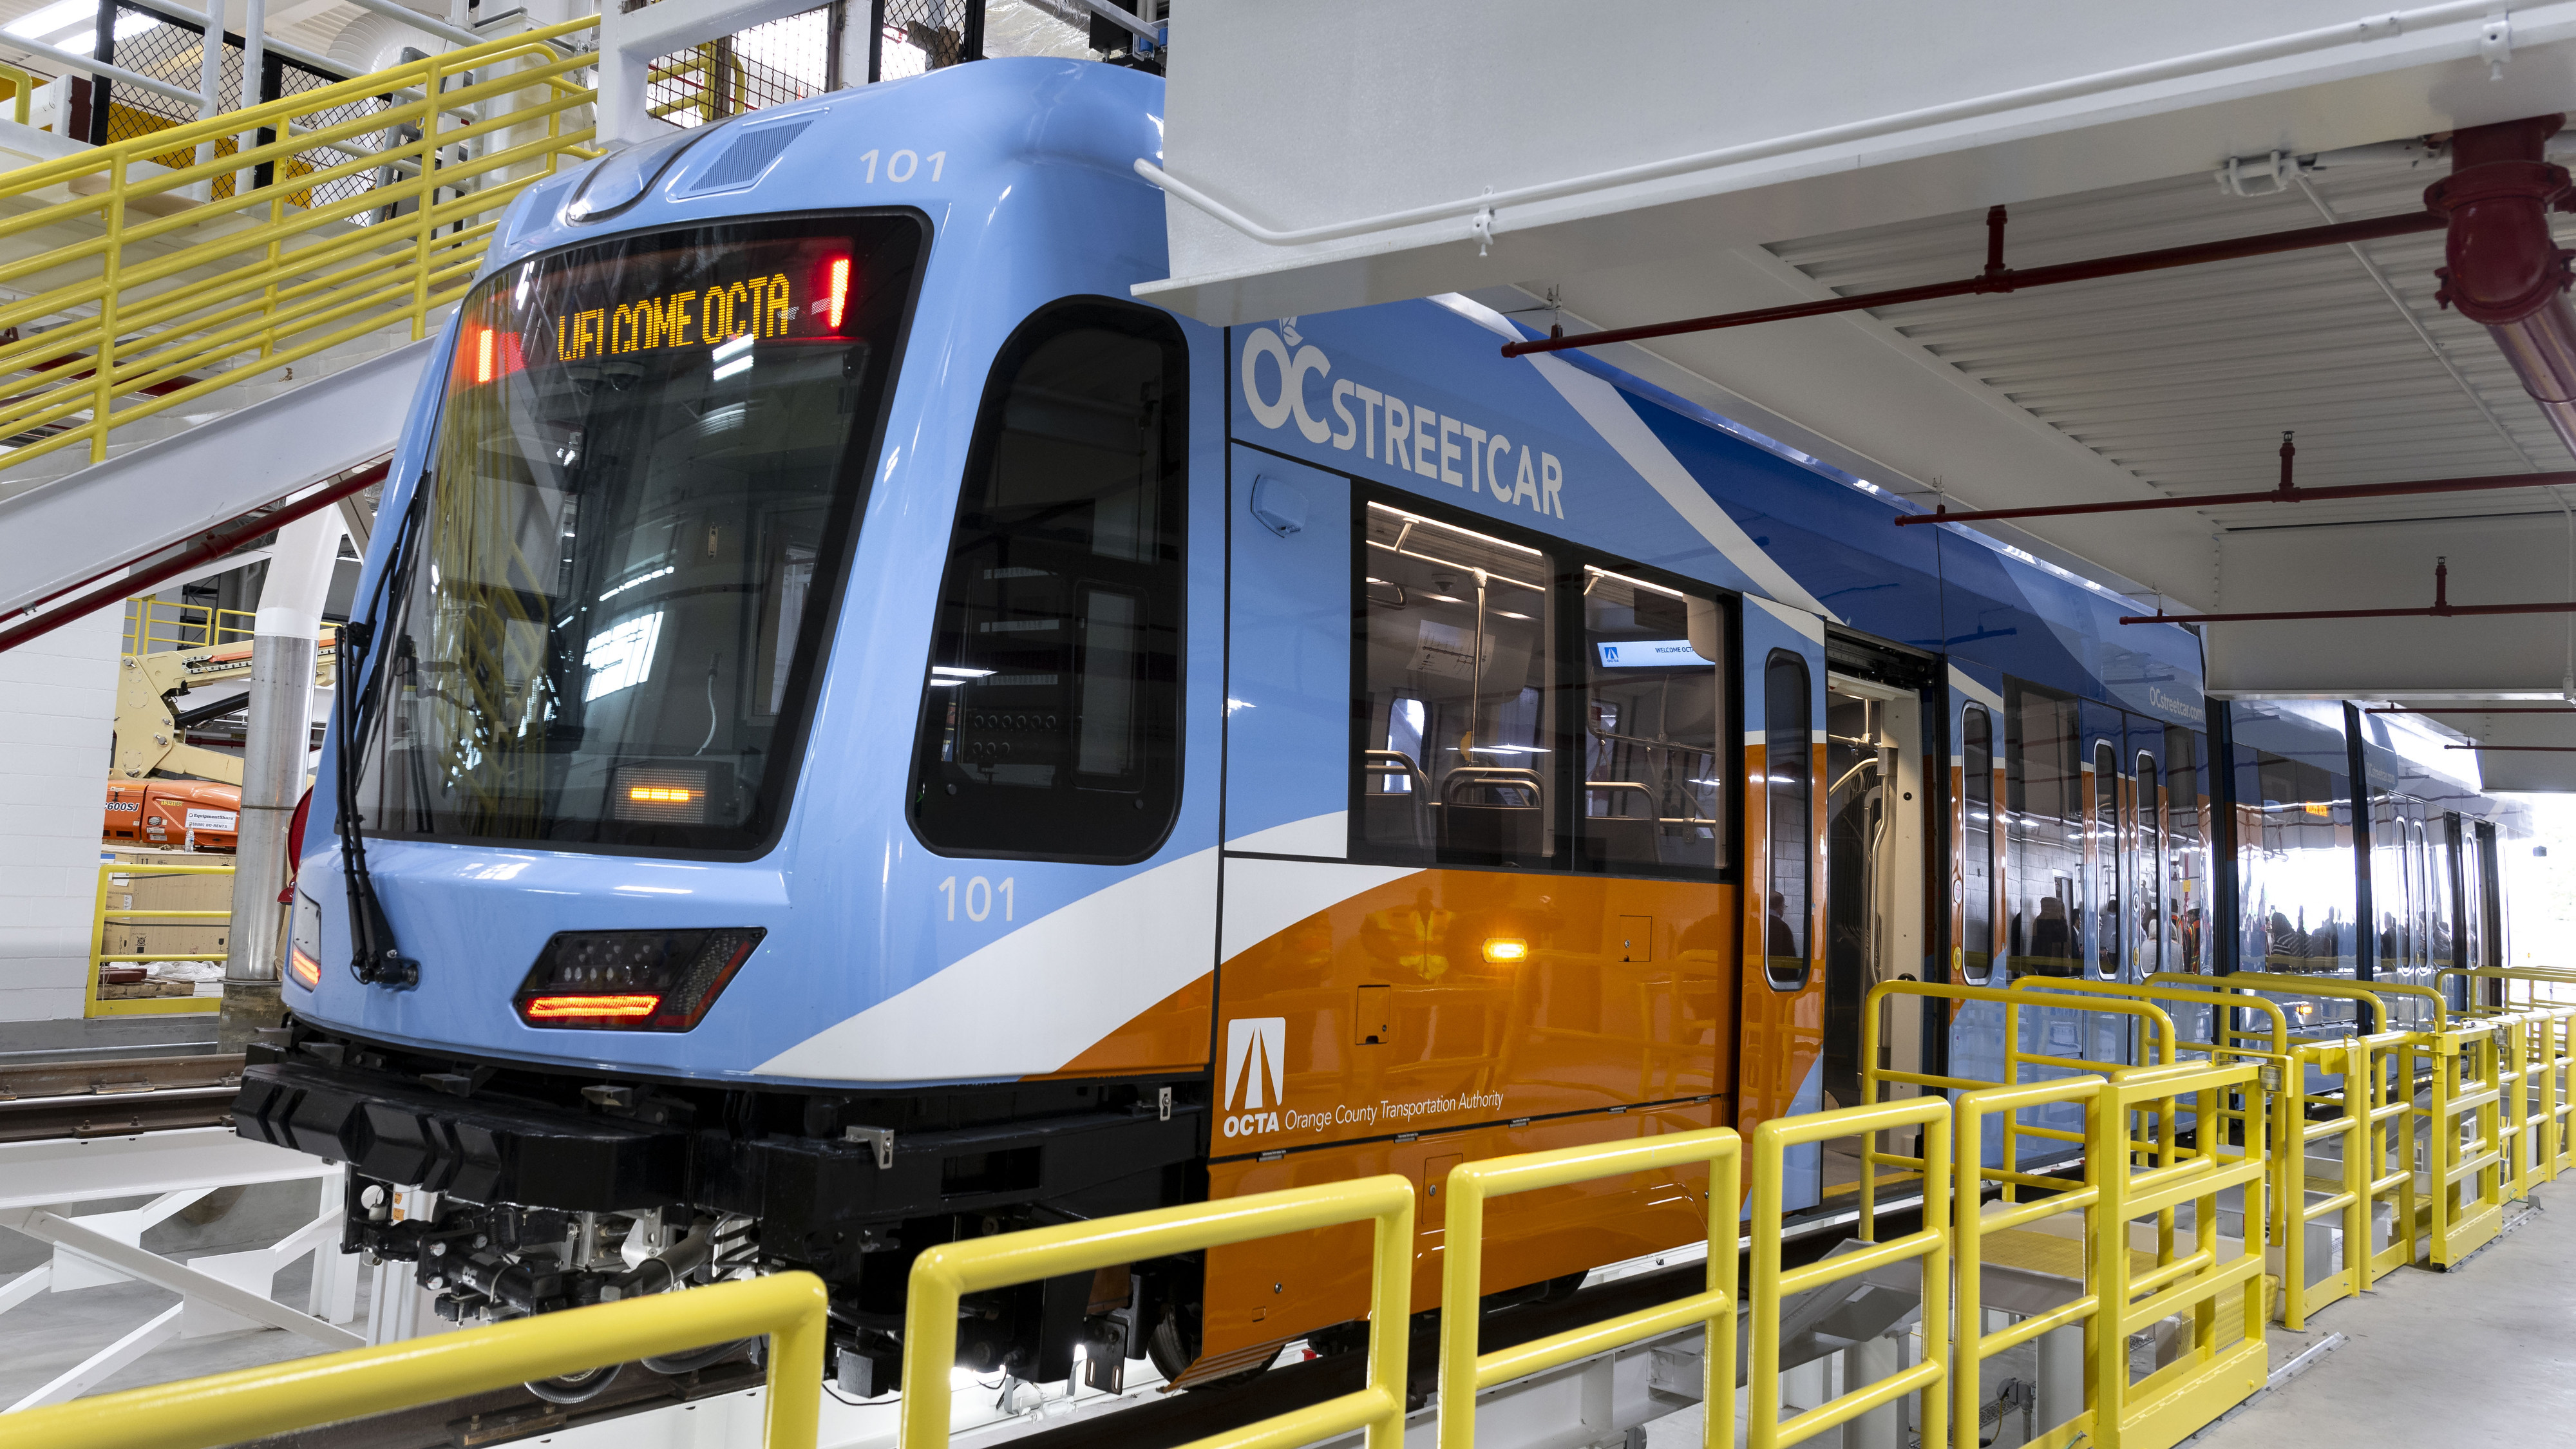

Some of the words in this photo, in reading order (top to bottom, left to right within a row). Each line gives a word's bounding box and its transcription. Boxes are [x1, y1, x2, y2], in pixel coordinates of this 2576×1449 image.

[860, 149, 946, 184] 101
[702, 273, 790, 345] OCTA
[2150, 686, 2203, 722] OCstreetcar.com
[938, 876, 1014, 922] 101
[1224, 1112, 1279, 1138] OCTA
[1284, 1110, 1332, 1132] Orange
[1335, 1104, 1378, 1126] County
[1380, 1095, 1456, 1122] Transportation
[1459, 1090, 1504, 1112] Authority
